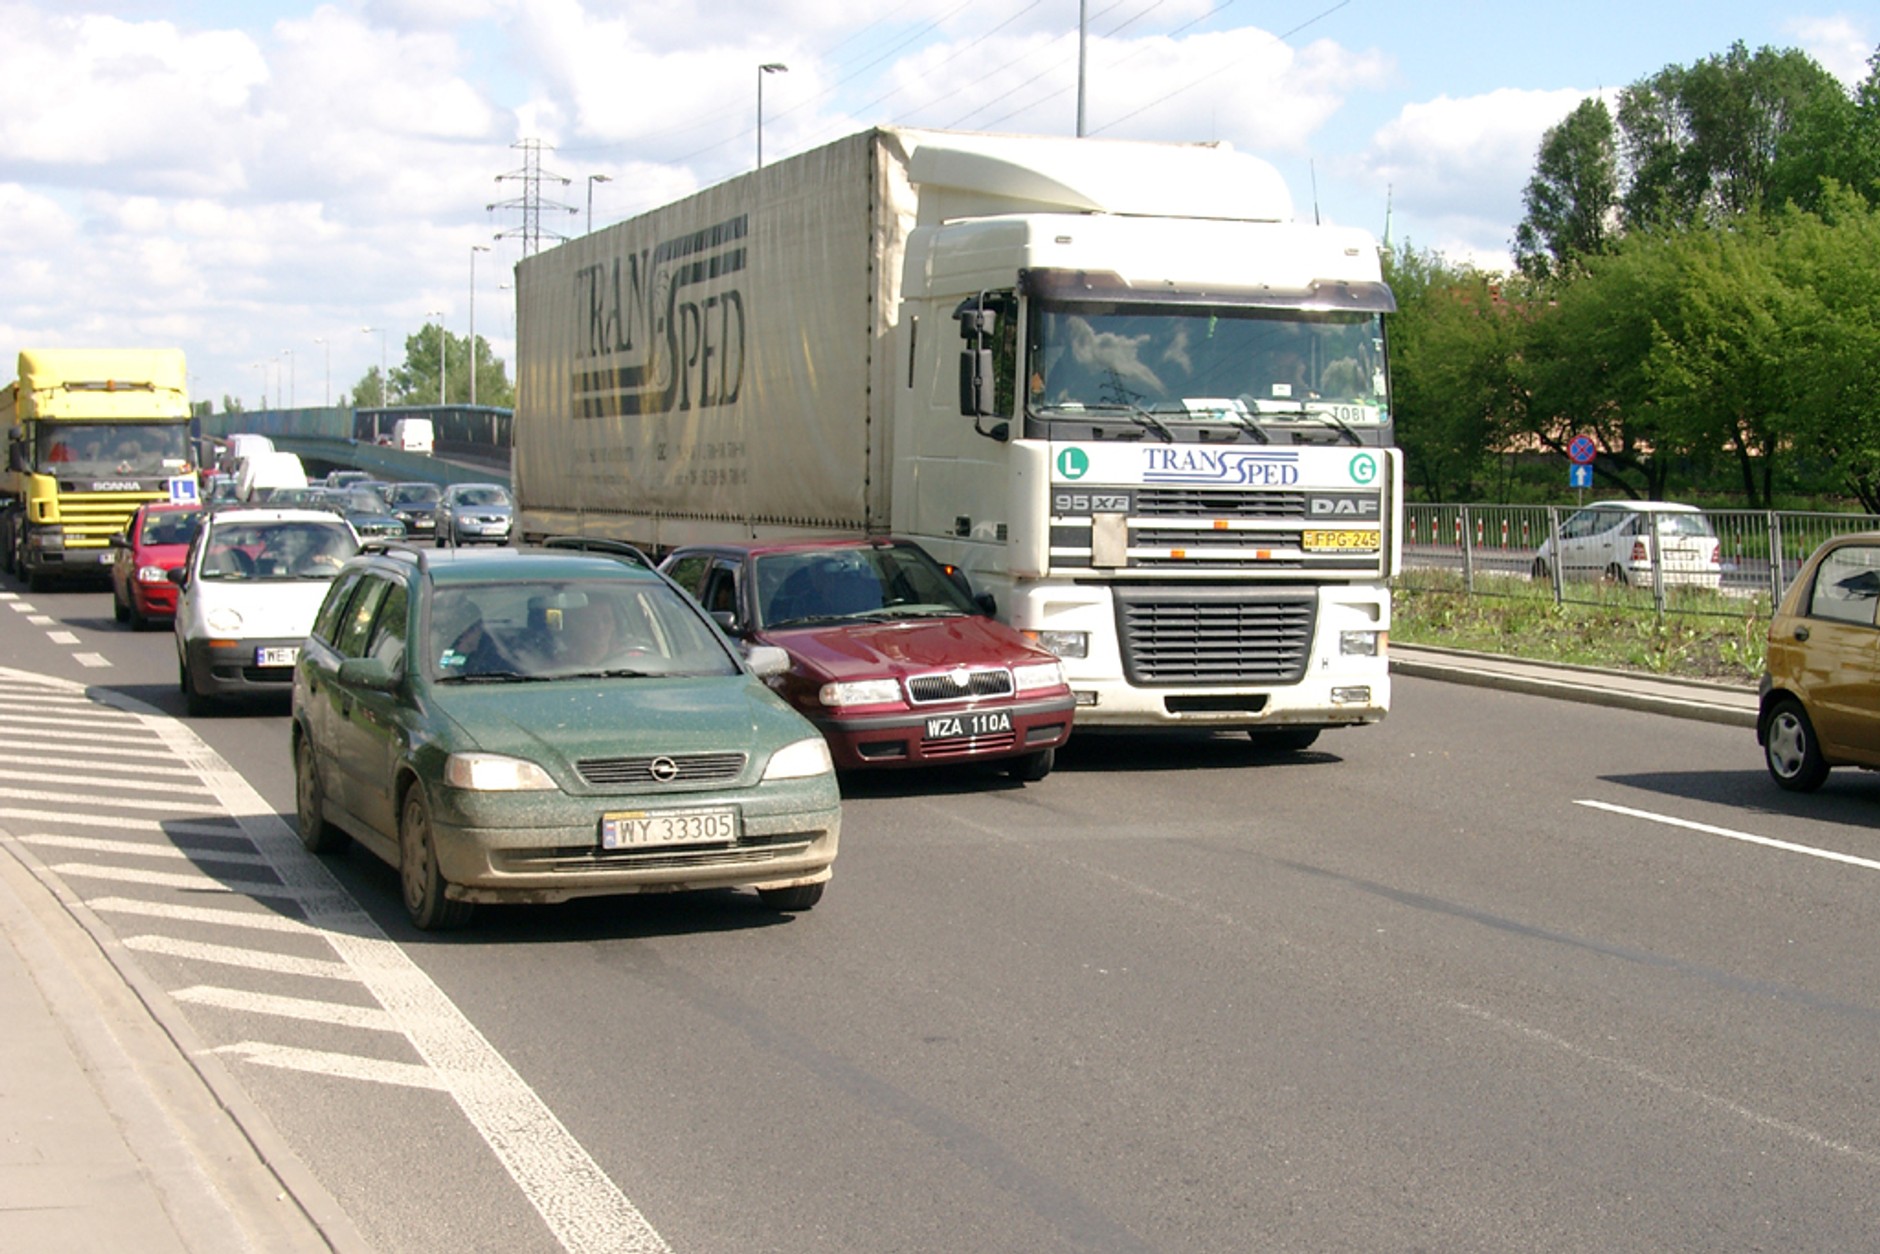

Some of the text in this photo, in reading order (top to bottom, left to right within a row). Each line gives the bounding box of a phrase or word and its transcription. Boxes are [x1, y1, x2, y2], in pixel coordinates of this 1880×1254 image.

[1065, 451, 1081, 475] L
[93, 481, 141, 491] SCANIA
[177, 480, 191, 498] L
[1311, 499, 1377, 514] DAF
[928, 713, 1010, 737] WZA 110A
[620, 815, 731, 843] WY 33305
